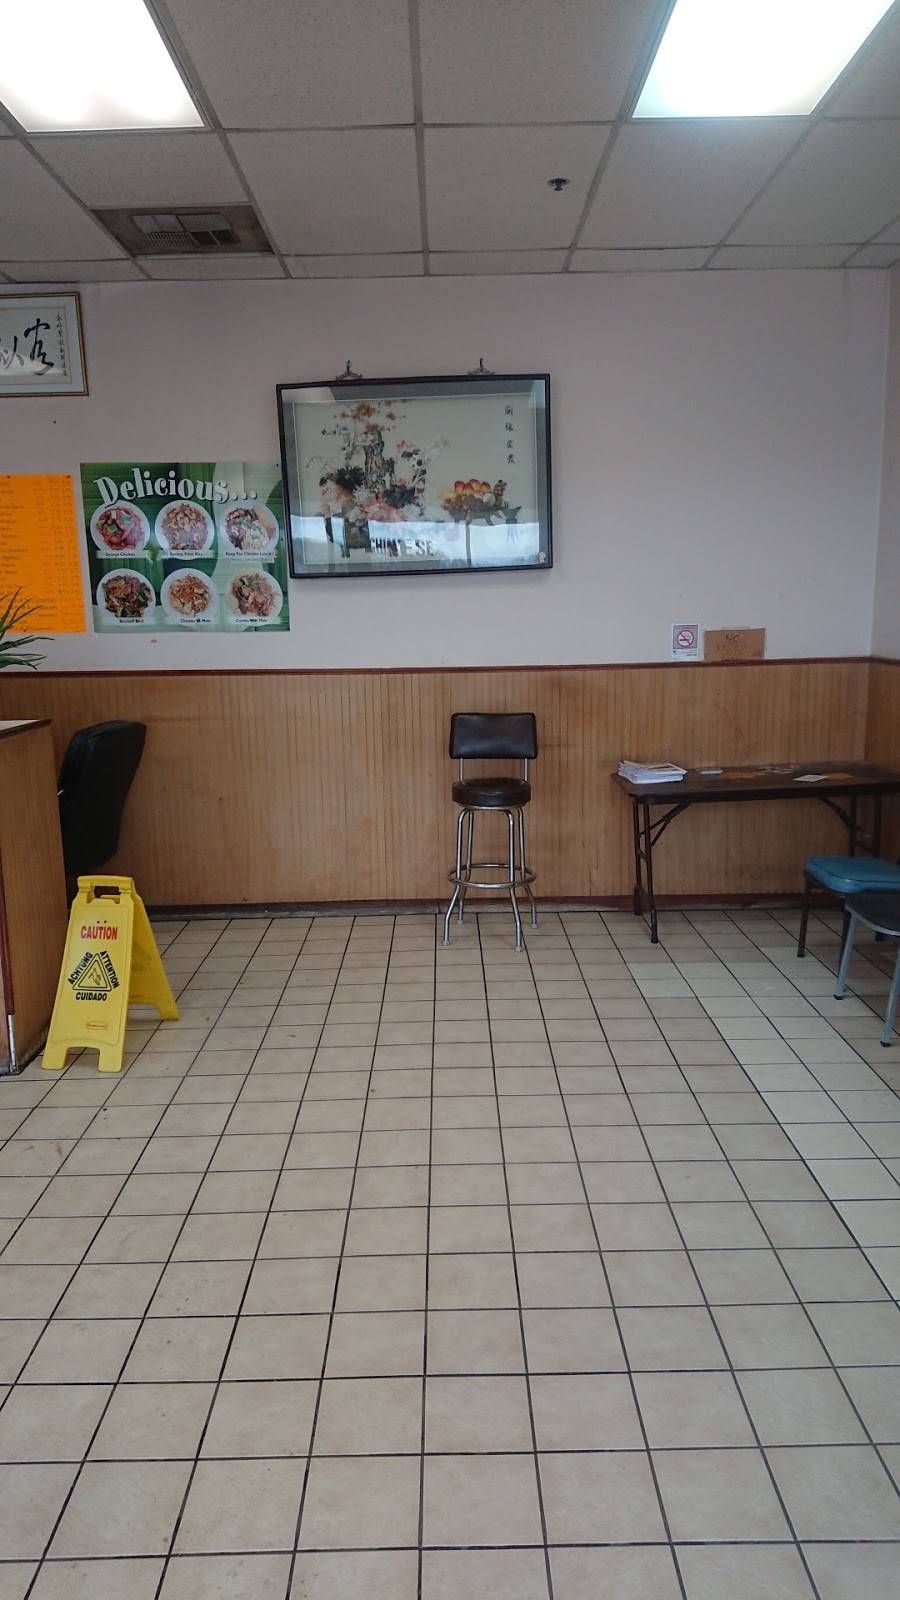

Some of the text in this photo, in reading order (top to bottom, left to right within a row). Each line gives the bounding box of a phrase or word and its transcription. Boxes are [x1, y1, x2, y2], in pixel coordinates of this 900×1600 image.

[80, 925, 118, 940] CAUTION
[68, 951, 93, 985] ACHTUNG
[99, 950, 120, 989] ATTENTION
[75, 991, 108, 1002] CUIDADO
